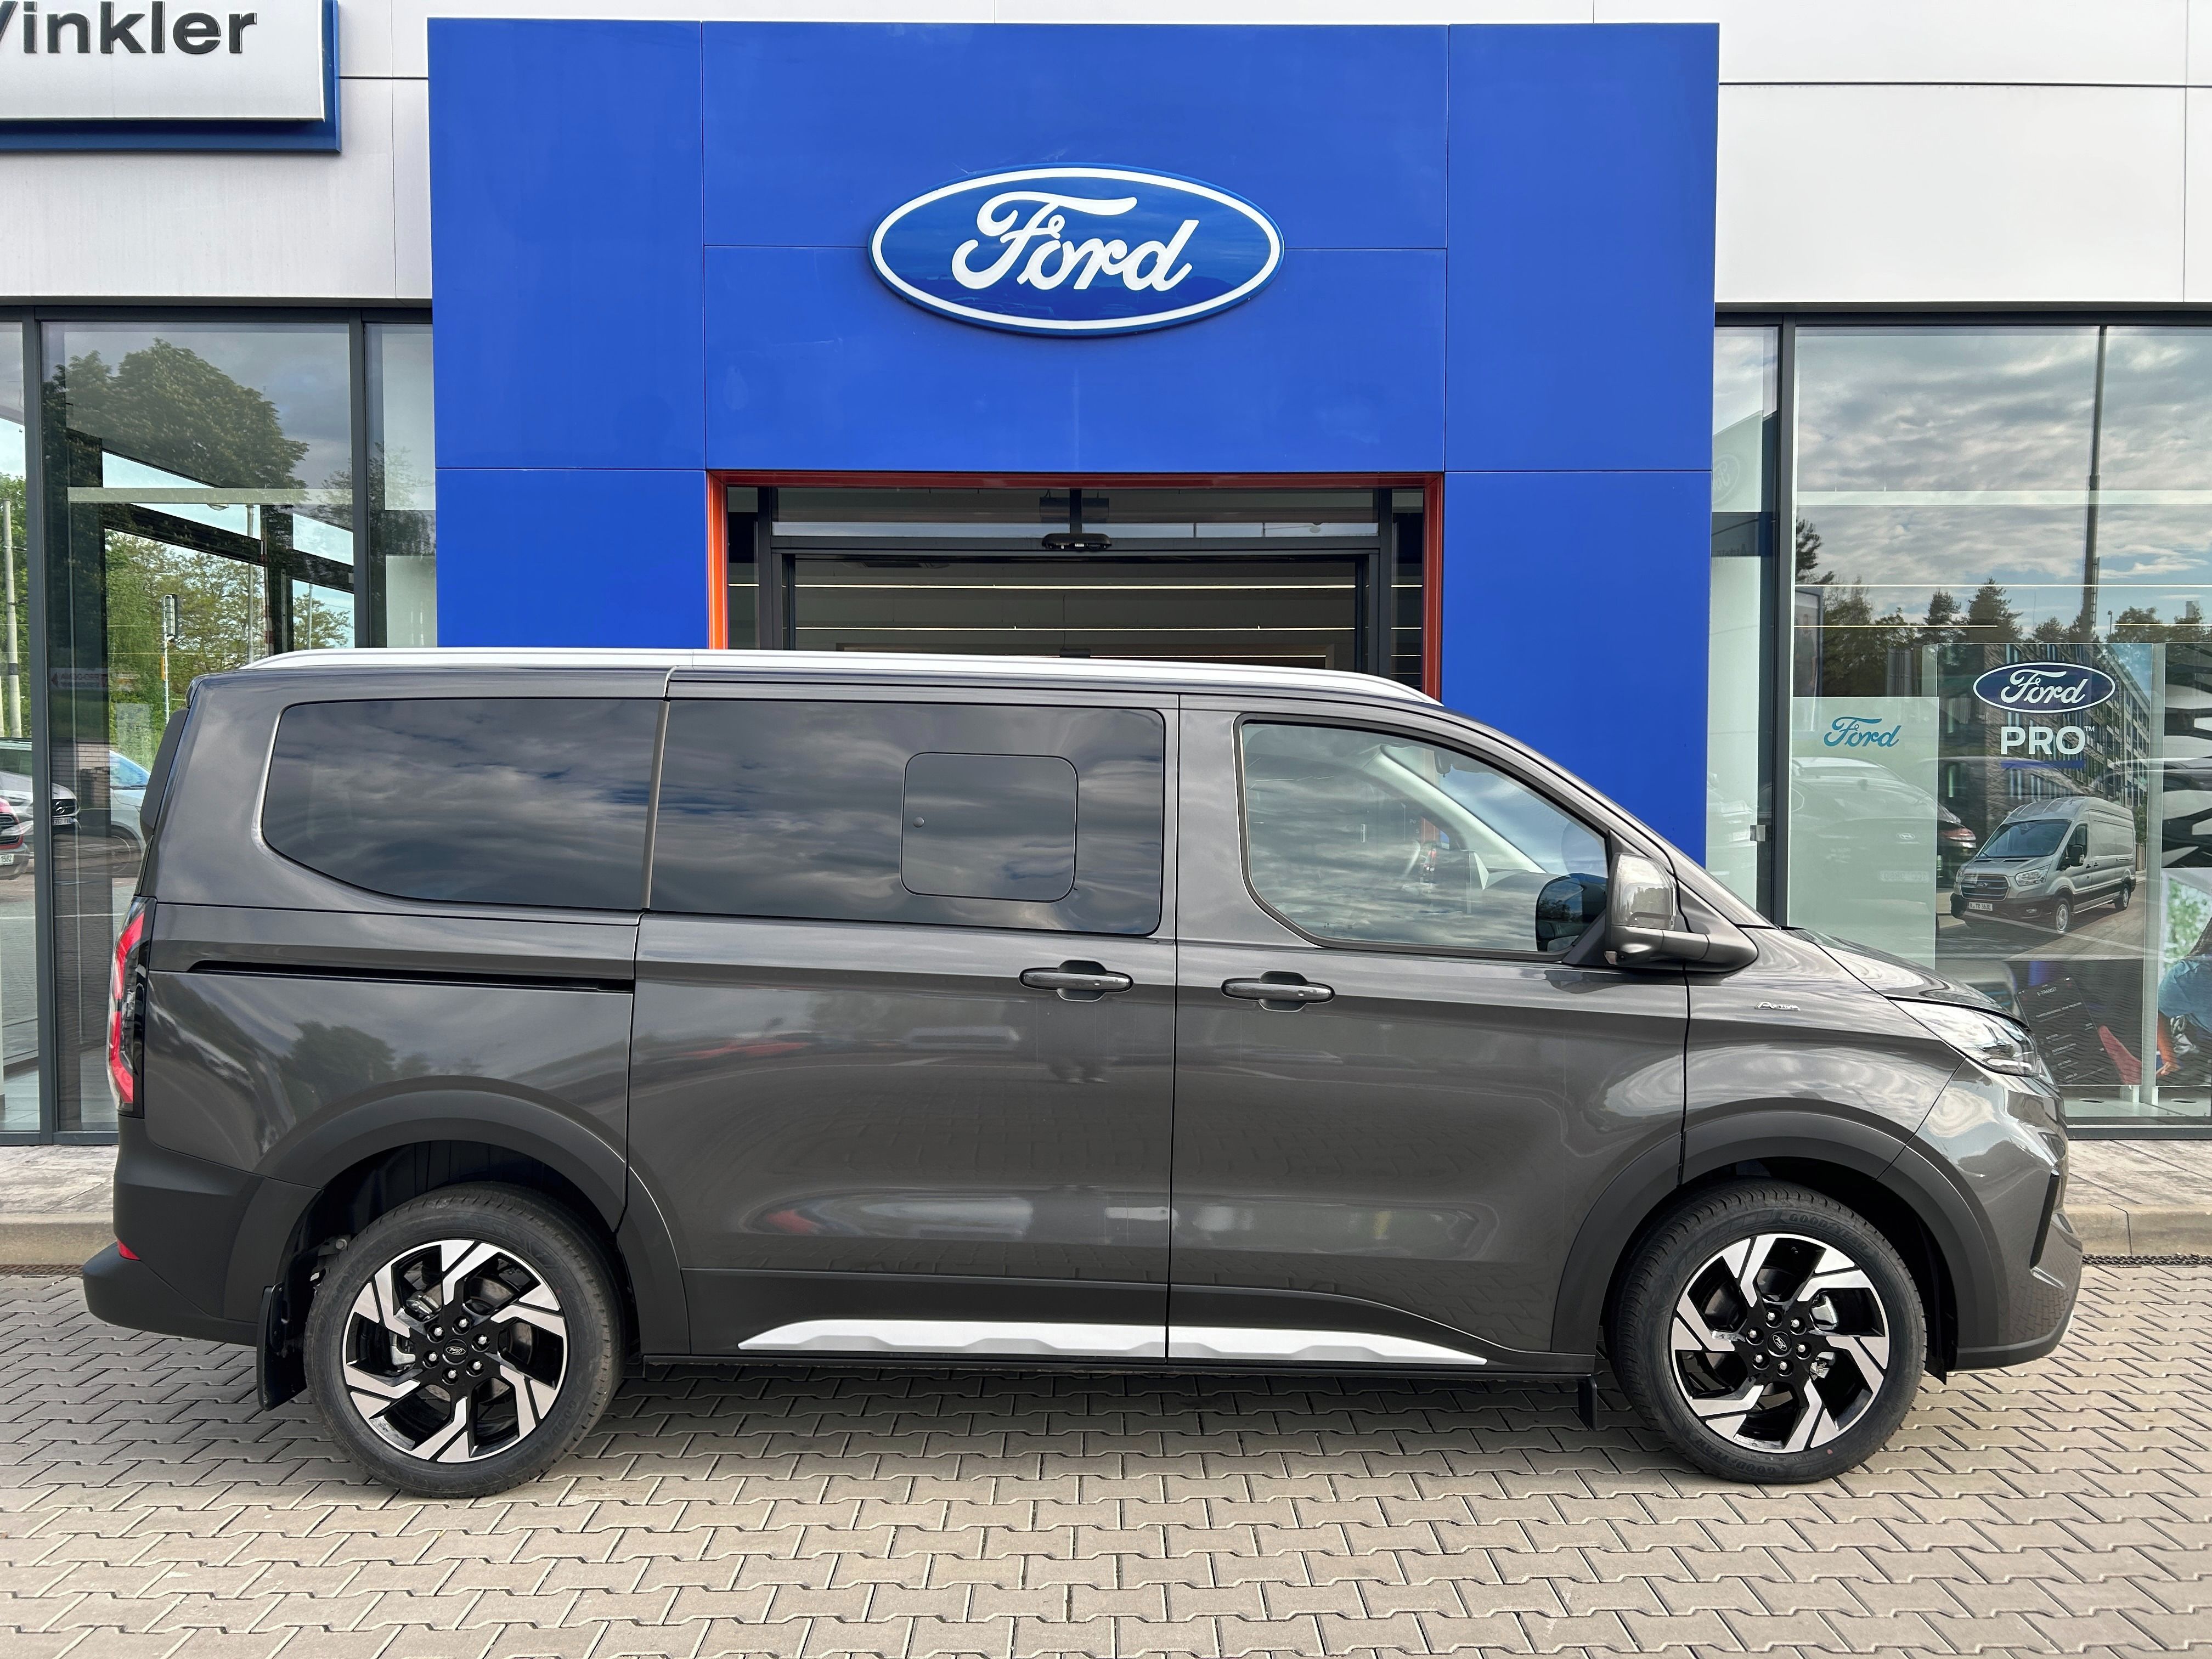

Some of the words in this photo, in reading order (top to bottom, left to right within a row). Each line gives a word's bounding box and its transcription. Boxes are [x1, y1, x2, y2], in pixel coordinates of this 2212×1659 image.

[0, 1, 257, 54] inkler
[951, 191, 1199, 291] Ford
[2001, 669, 2089, 704] Ford
[1824, 716, 1901, 747] Ford
[2000, 726, 2085, 755] PRO
